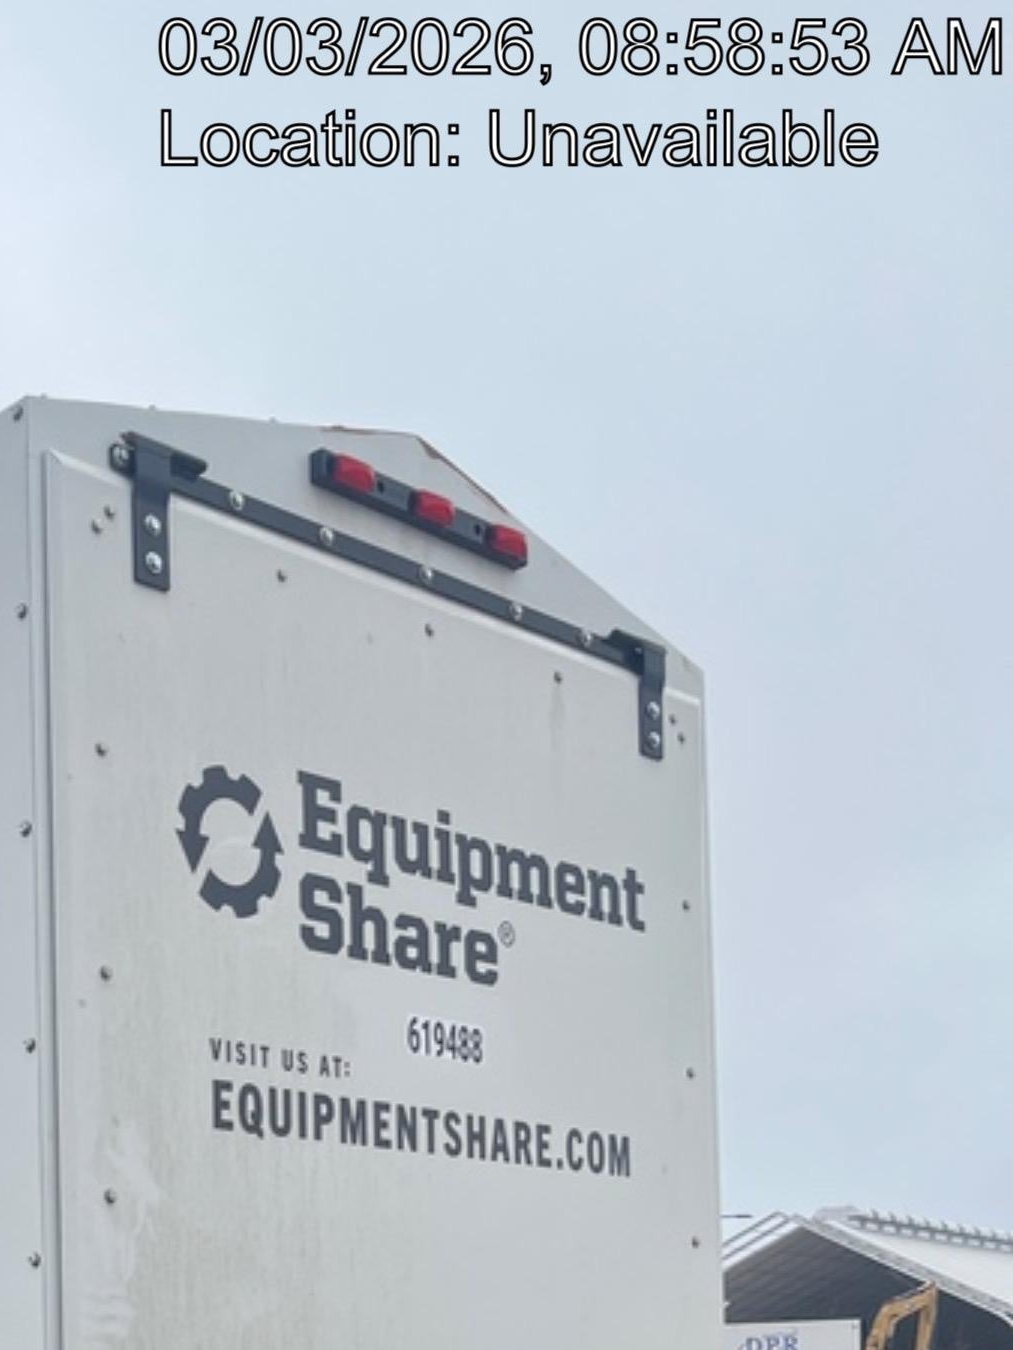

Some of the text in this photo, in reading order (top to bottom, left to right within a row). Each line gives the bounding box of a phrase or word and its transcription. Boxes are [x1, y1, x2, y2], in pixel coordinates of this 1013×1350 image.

[296, 769, 646, 932] Equipment
[209, 1037, 351, 1078] VISIT US AT:
[407, 1015, 483, 1064] 619488
[211, 1079, 632, 1178] EQUIPMENTSHARE.COM
